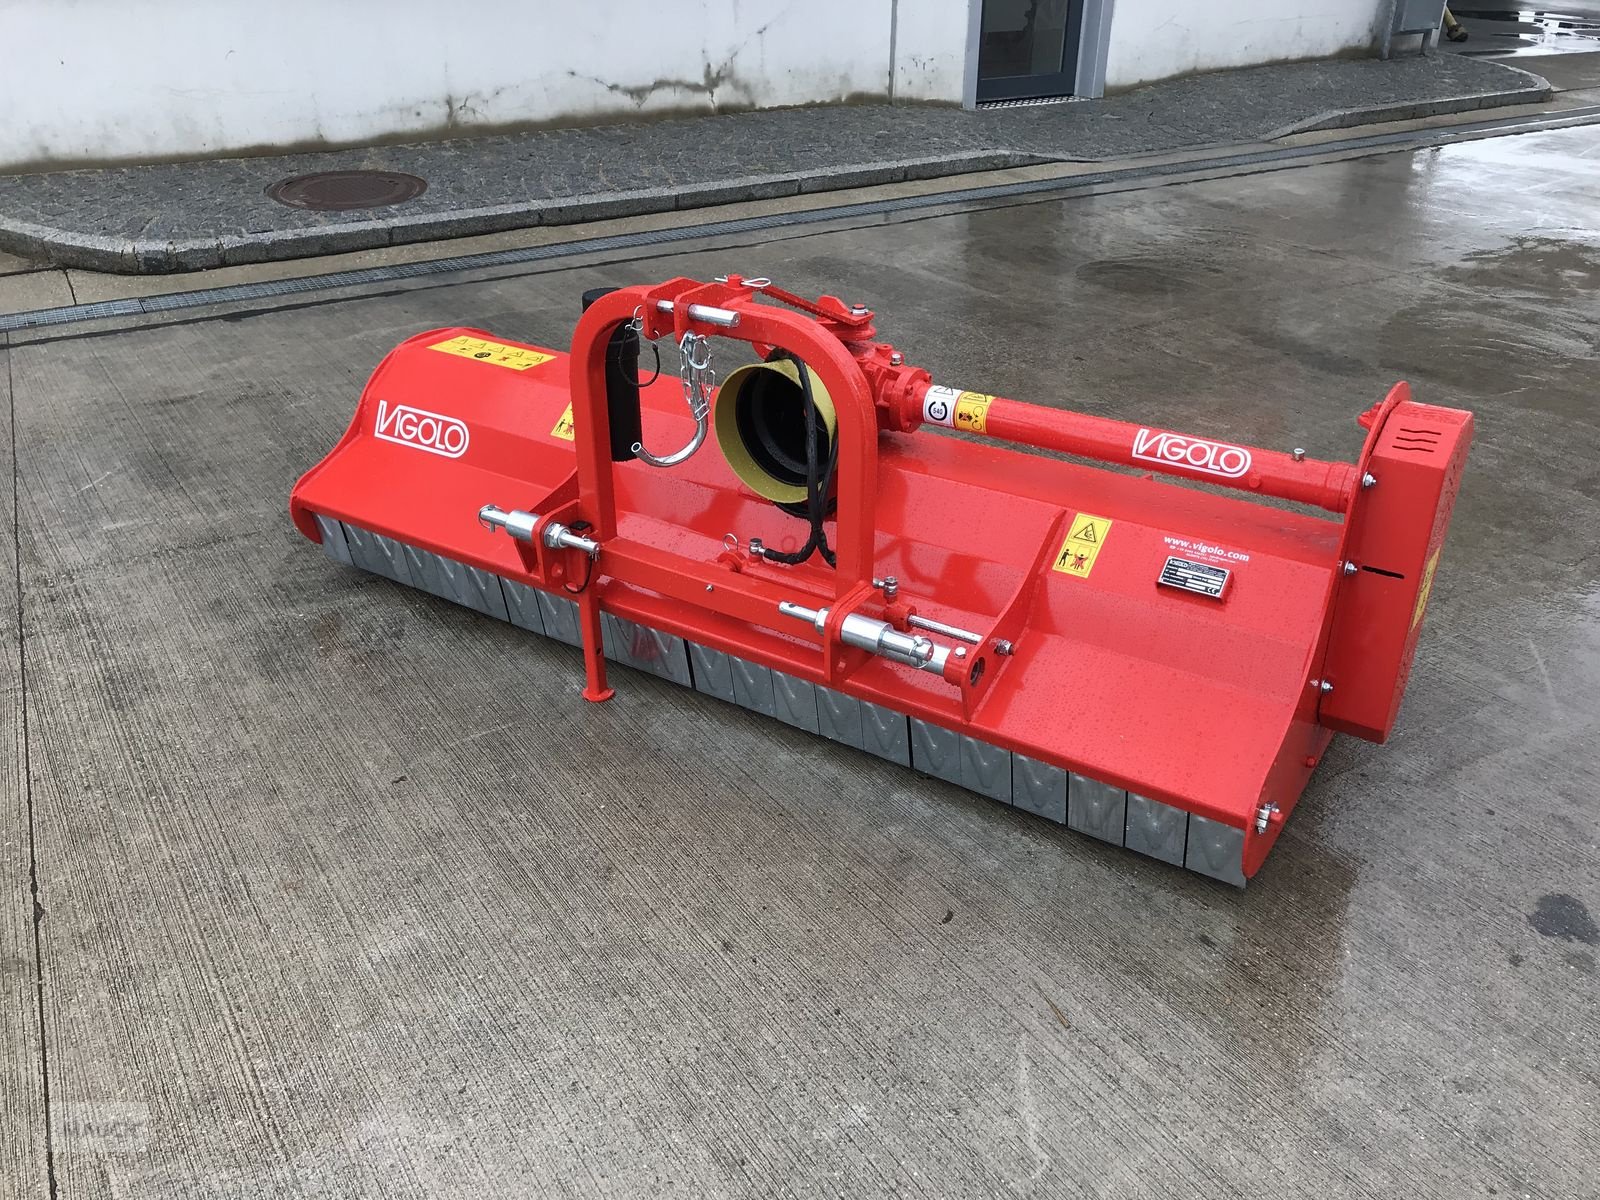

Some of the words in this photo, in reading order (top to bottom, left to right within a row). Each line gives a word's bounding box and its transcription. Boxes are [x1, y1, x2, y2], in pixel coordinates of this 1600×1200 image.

[375, 400, 467, 456] VIGOLO
[932, 407, 943, 415] 540
[1133, 427, 1249, 476] VIGOLO
[1163, 536, 1250, 562] www.vigolo.com
